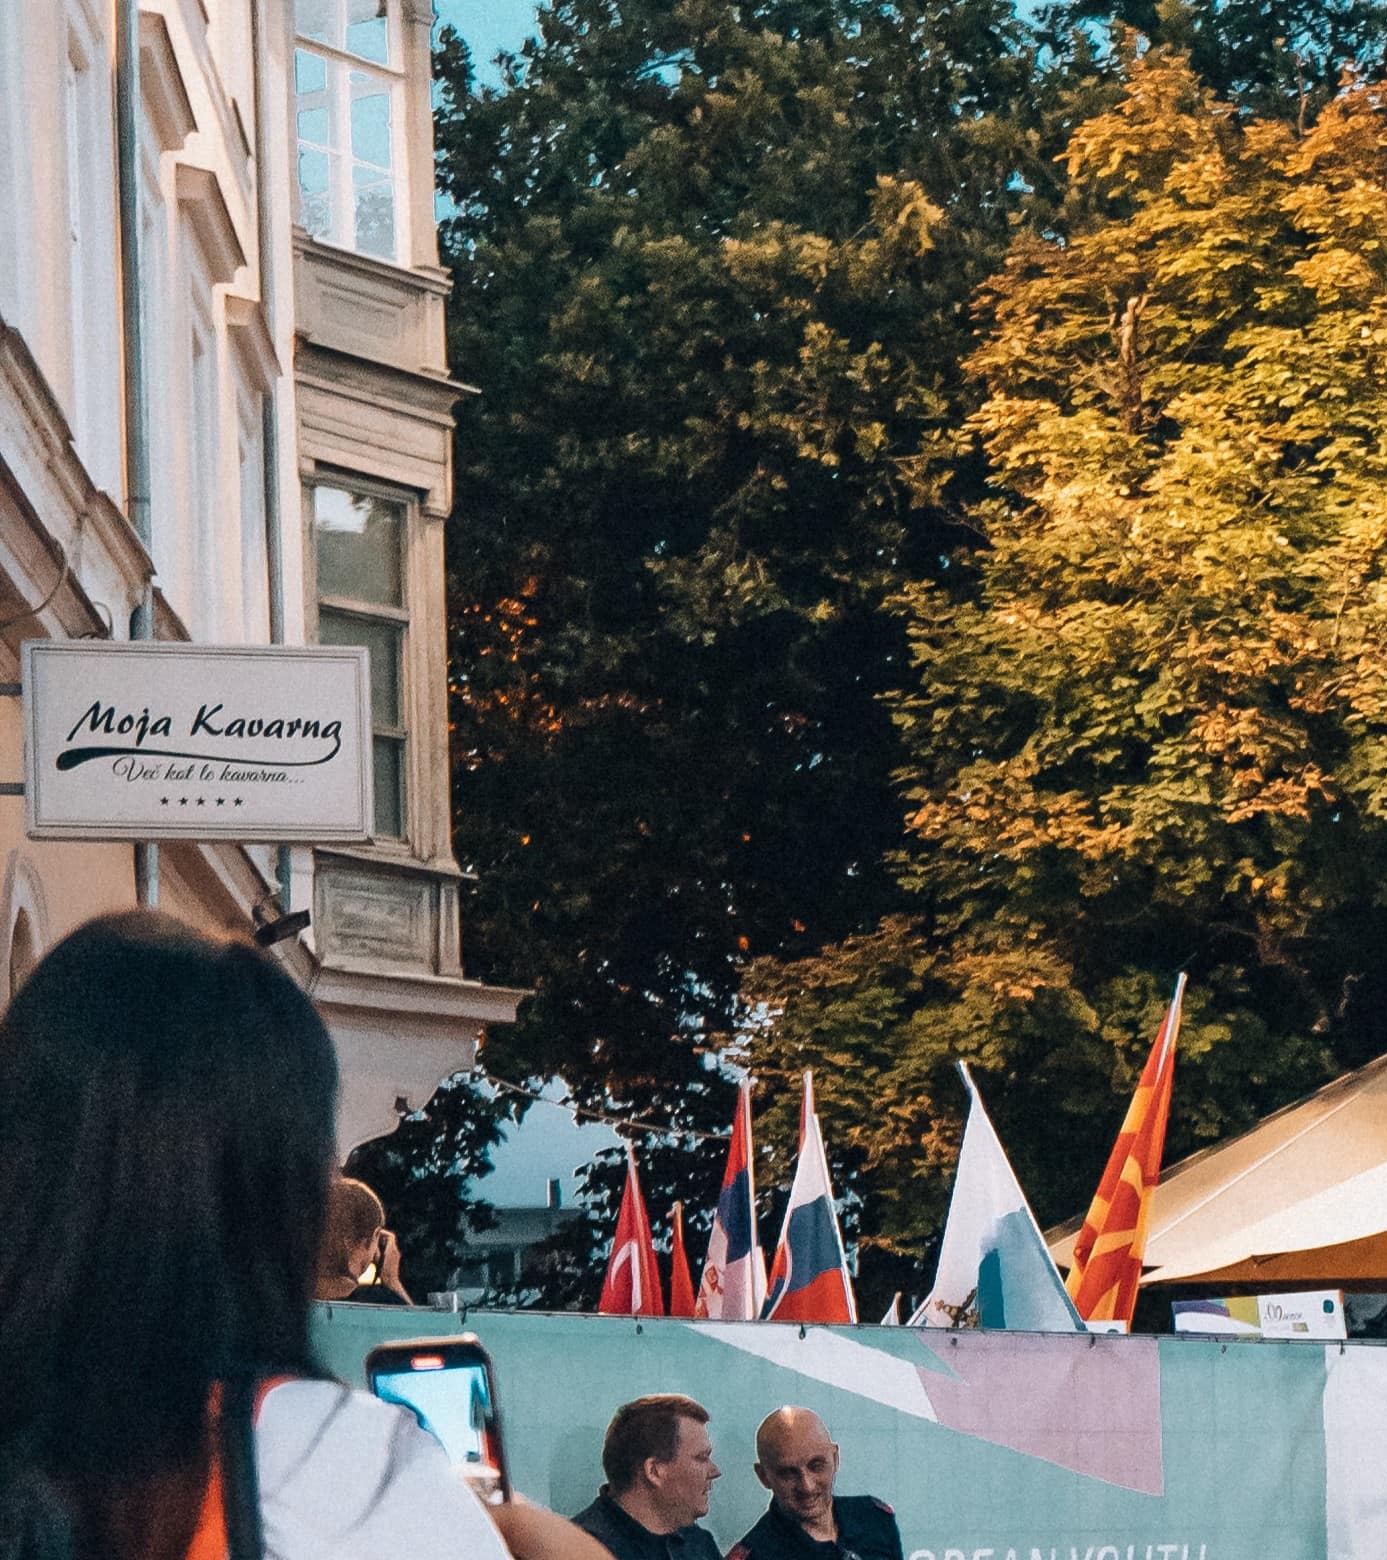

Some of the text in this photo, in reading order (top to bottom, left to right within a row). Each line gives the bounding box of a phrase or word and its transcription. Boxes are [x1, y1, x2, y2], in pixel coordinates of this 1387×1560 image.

[66, 700, 342, 746] Moja Kavarna
[199, 764, 215, 781] le
